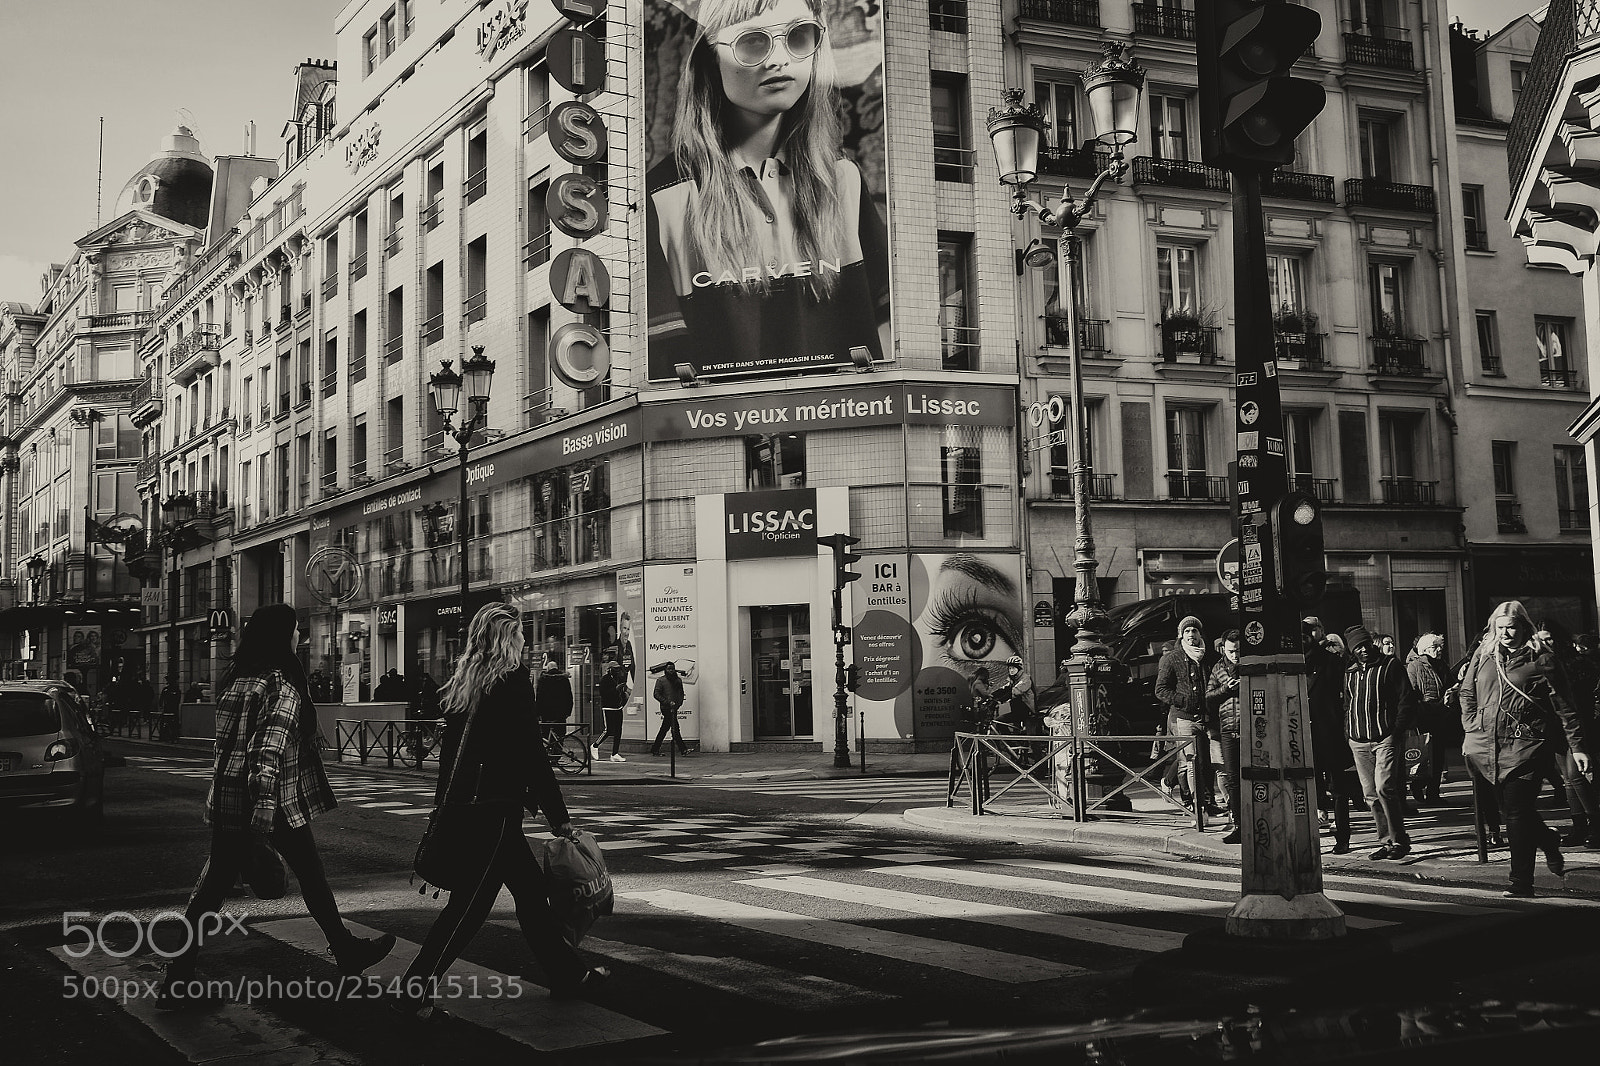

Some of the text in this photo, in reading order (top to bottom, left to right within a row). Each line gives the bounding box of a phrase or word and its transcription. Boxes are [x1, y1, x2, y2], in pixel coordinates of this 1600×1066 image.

[691, 257, 842, 288] CARVEN
[713, 362, 735, 370] VENTE
[755, 358, 778, 367] VOTRE
[779, 356, 810, 364] MAGASIN
[811, 353, 835, 361] LISSAC
[907, 394, 981, 416] Lissac
[686, 395, 893, 431] Vos yeux méritent
[562, 423, 628, 456] Basse vision
[389, 494, 398, 508] de
[397, 486, 422, 505] contact
[728, 508, 814, 534] LISSAC
[762, 531, 801, 542] l'Opticien
[874, 563, 897, 580] ICI
[872, 582, 902, 593] BAR à
[867, 596, 907, 606] lentilles
[437, 606, 462, 616] CARVEN
[650, 605, 693, 613] INNOVANTES
[668, 614, 690, 622] LISENT
[649, 643, 672, 652] MyEye
[924, 687, 935, 695] de
[936, 687, 957, 695] 3500
